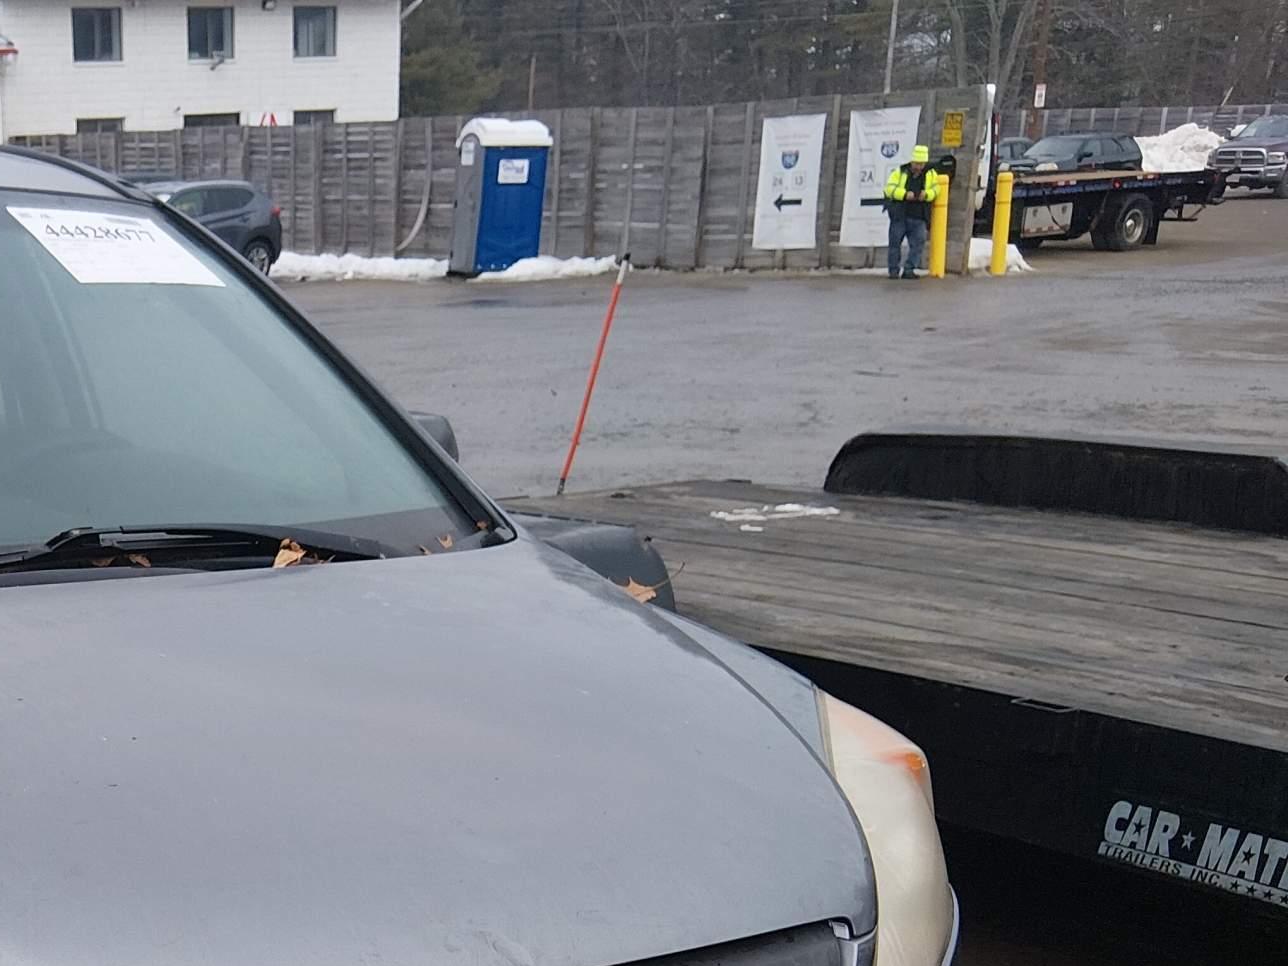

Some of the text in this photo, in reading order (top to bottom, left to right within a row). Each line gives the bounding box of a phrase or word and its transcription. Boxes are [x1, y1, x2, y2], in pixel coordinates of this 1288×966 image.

[45, 224, 156, 243] 44428677
[1104, 800, 1180, 858] CAR
[1105, 843, 1223, 889] TRAILERS INC.
